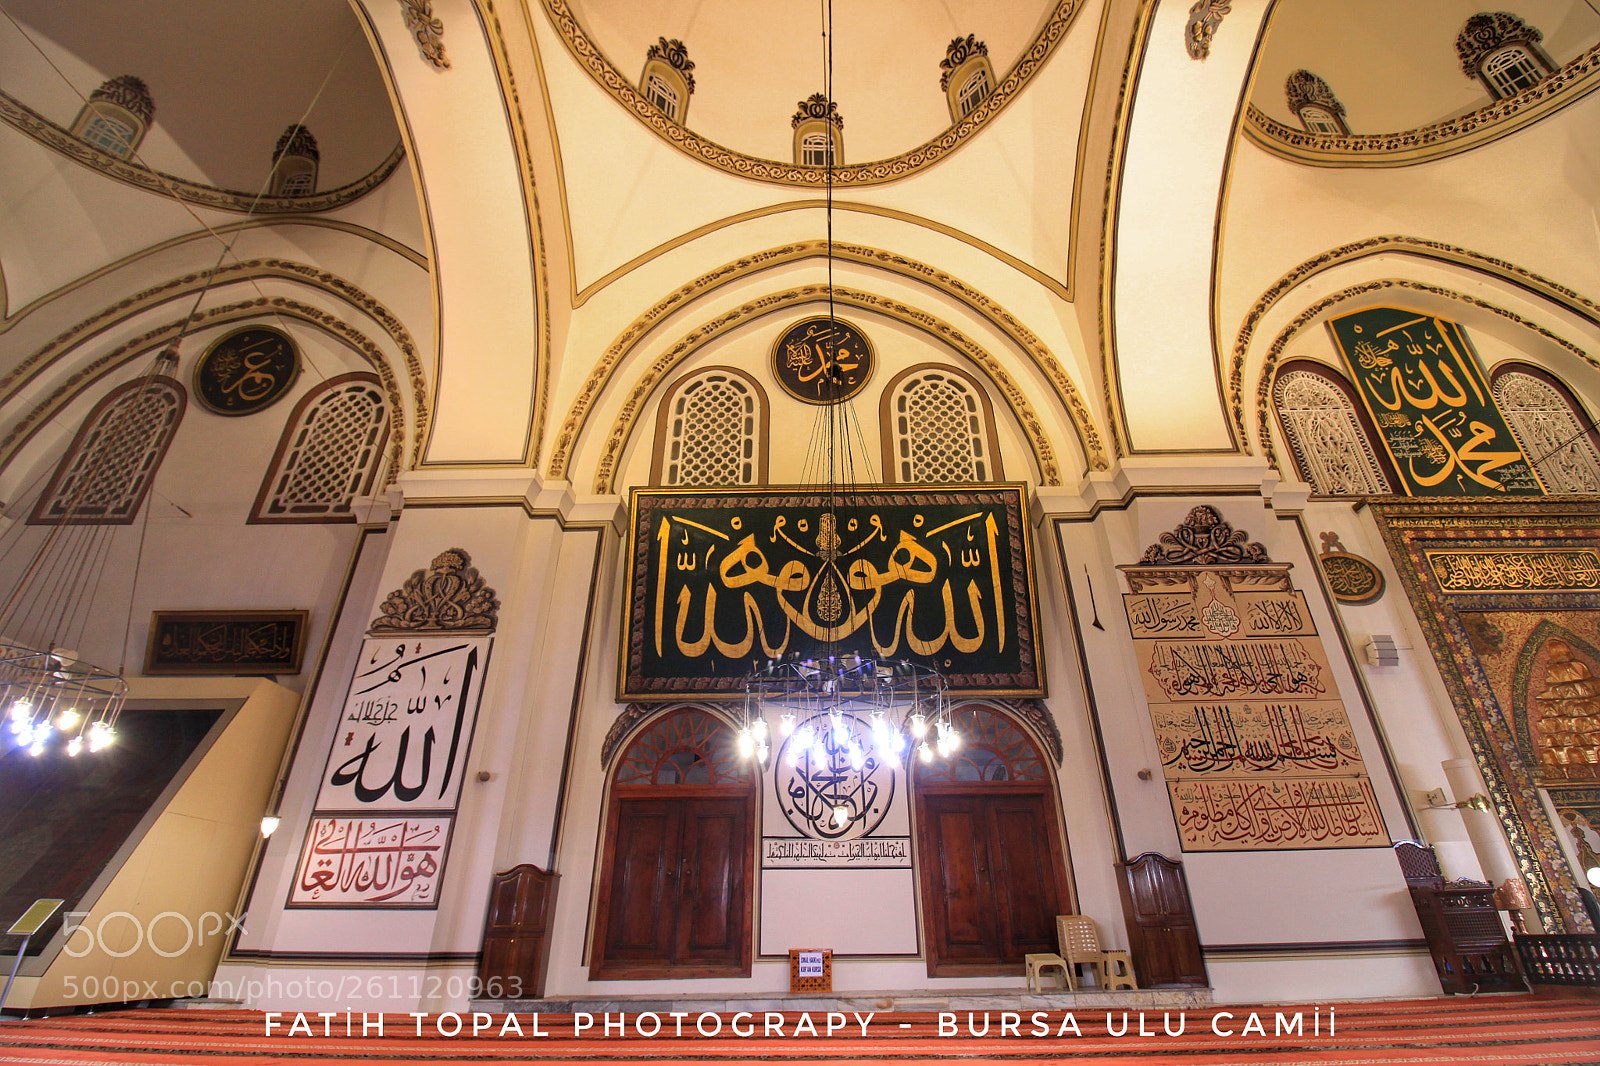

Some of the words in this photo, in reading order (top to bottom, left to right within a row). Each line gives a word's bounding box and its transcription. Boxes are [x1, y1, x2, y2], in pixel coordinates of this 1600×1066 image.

[1364, 317, 1486, 411] الله
[1410, 413, 1522, 492] محمد
[330, 645, 478, 803] الله
